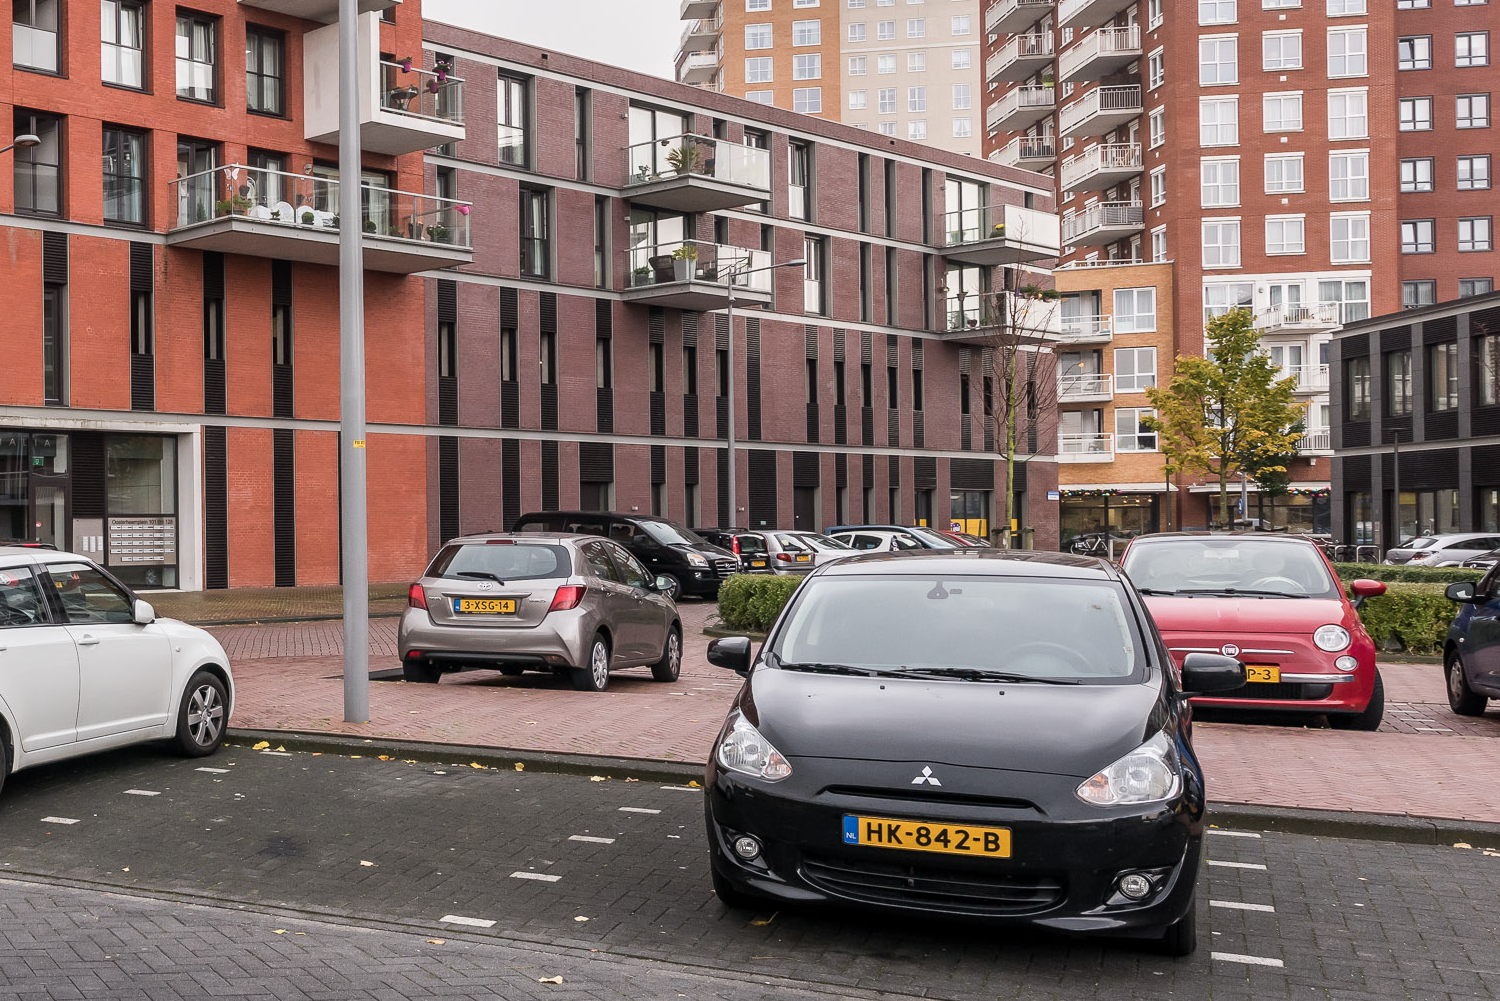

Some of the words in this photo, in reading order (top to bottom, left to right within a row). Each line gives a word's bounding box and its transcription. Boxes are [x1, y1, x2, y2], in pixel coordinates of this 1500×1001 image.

[464, 601, 509, 610] 3-XSG-14
[845, 832, 857, 840] NL
[866, 821, 1001, 853] HK-842-B
